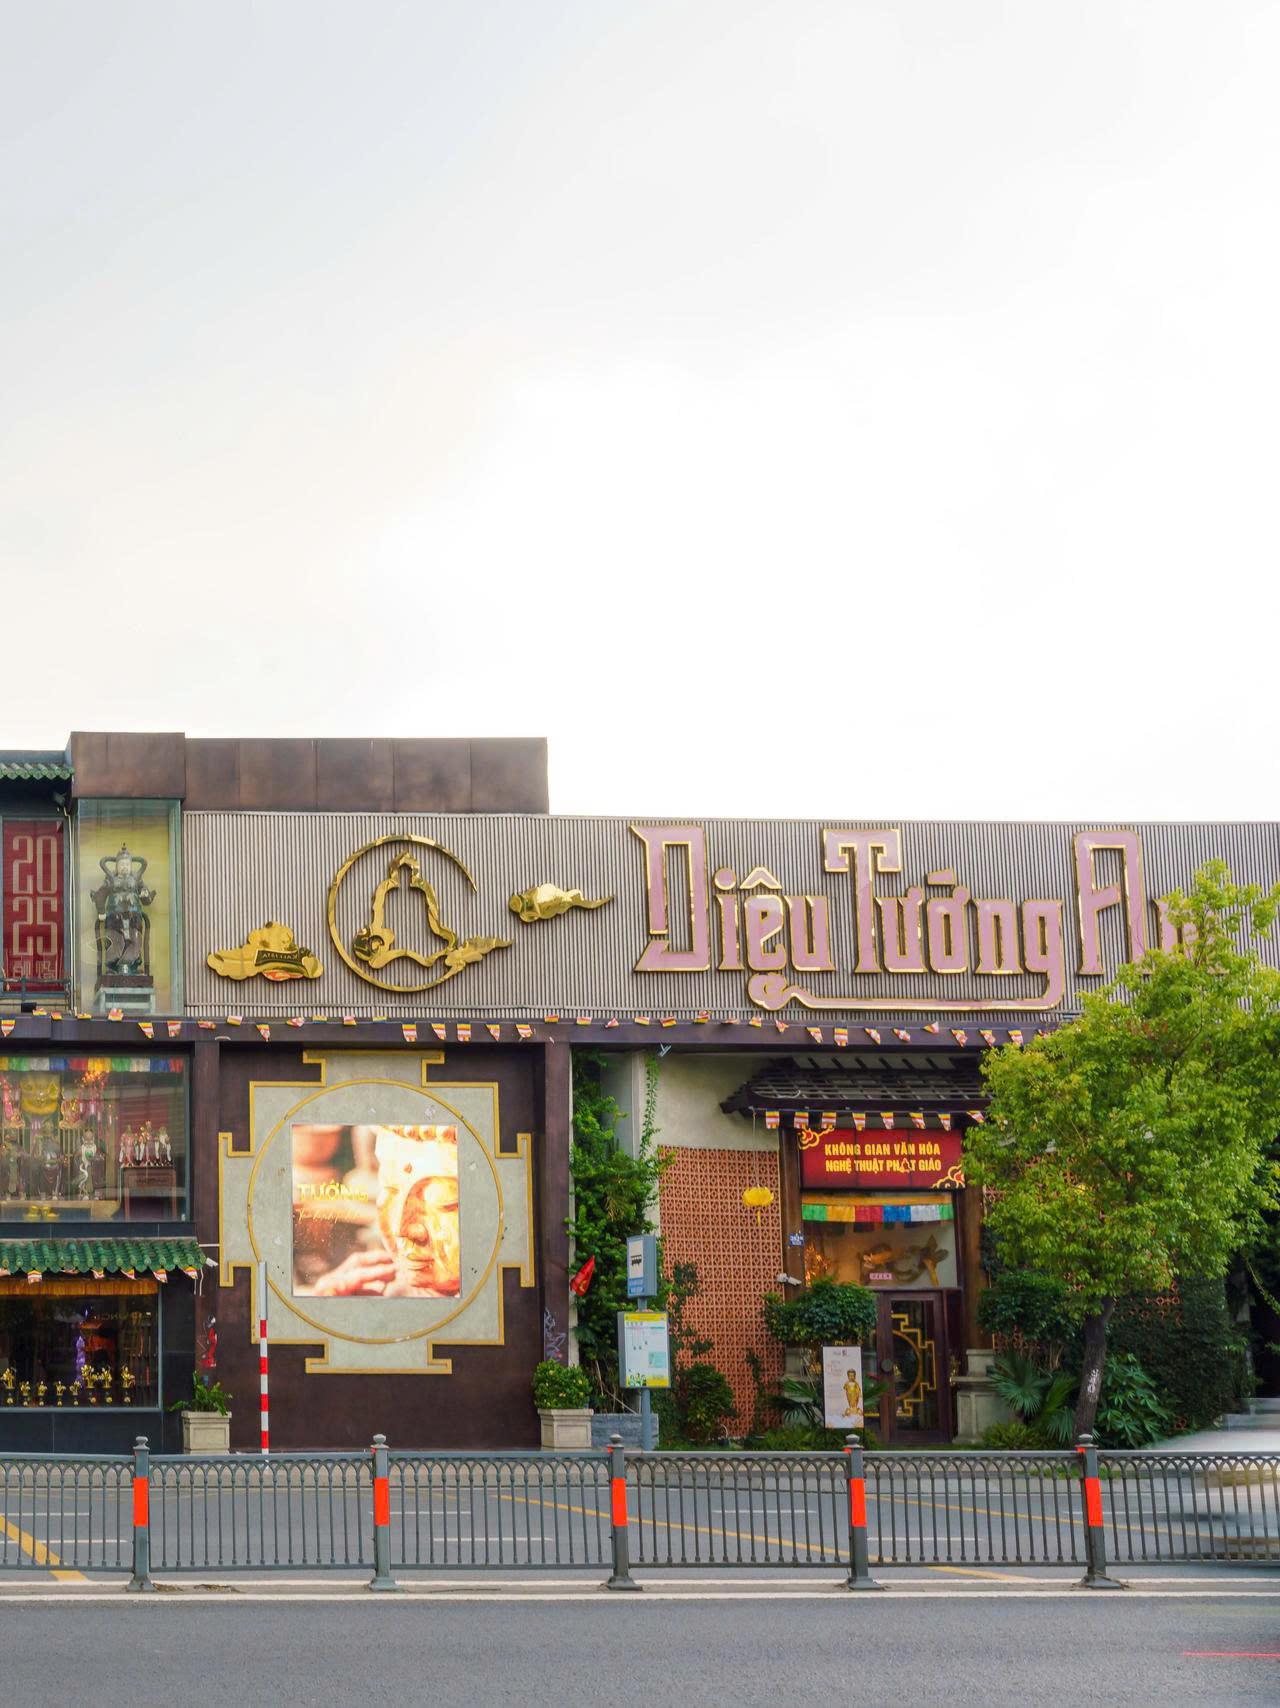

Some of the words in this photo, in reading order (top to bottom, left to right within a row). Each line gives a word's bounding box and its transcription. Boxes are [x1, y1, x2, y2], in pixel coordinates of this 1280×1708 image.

[12, 835, 58, 894] 20
[12, 896, 58, 956] 25
[629, 824, 837, 1011] Diệu
[822, 828, 1066, 1011] Tướng
[824, 1141, 862, 1156] KHÔNG
[864, 1143, 891, 1156] GIAN
[893, 1141, 916, 1156] VĂN
[825, 1158, 852, 1174] NGHỆ
[854, 1158, 884, 1174] THUẬT
[918, 1158, 942, 1172] GIÁO
